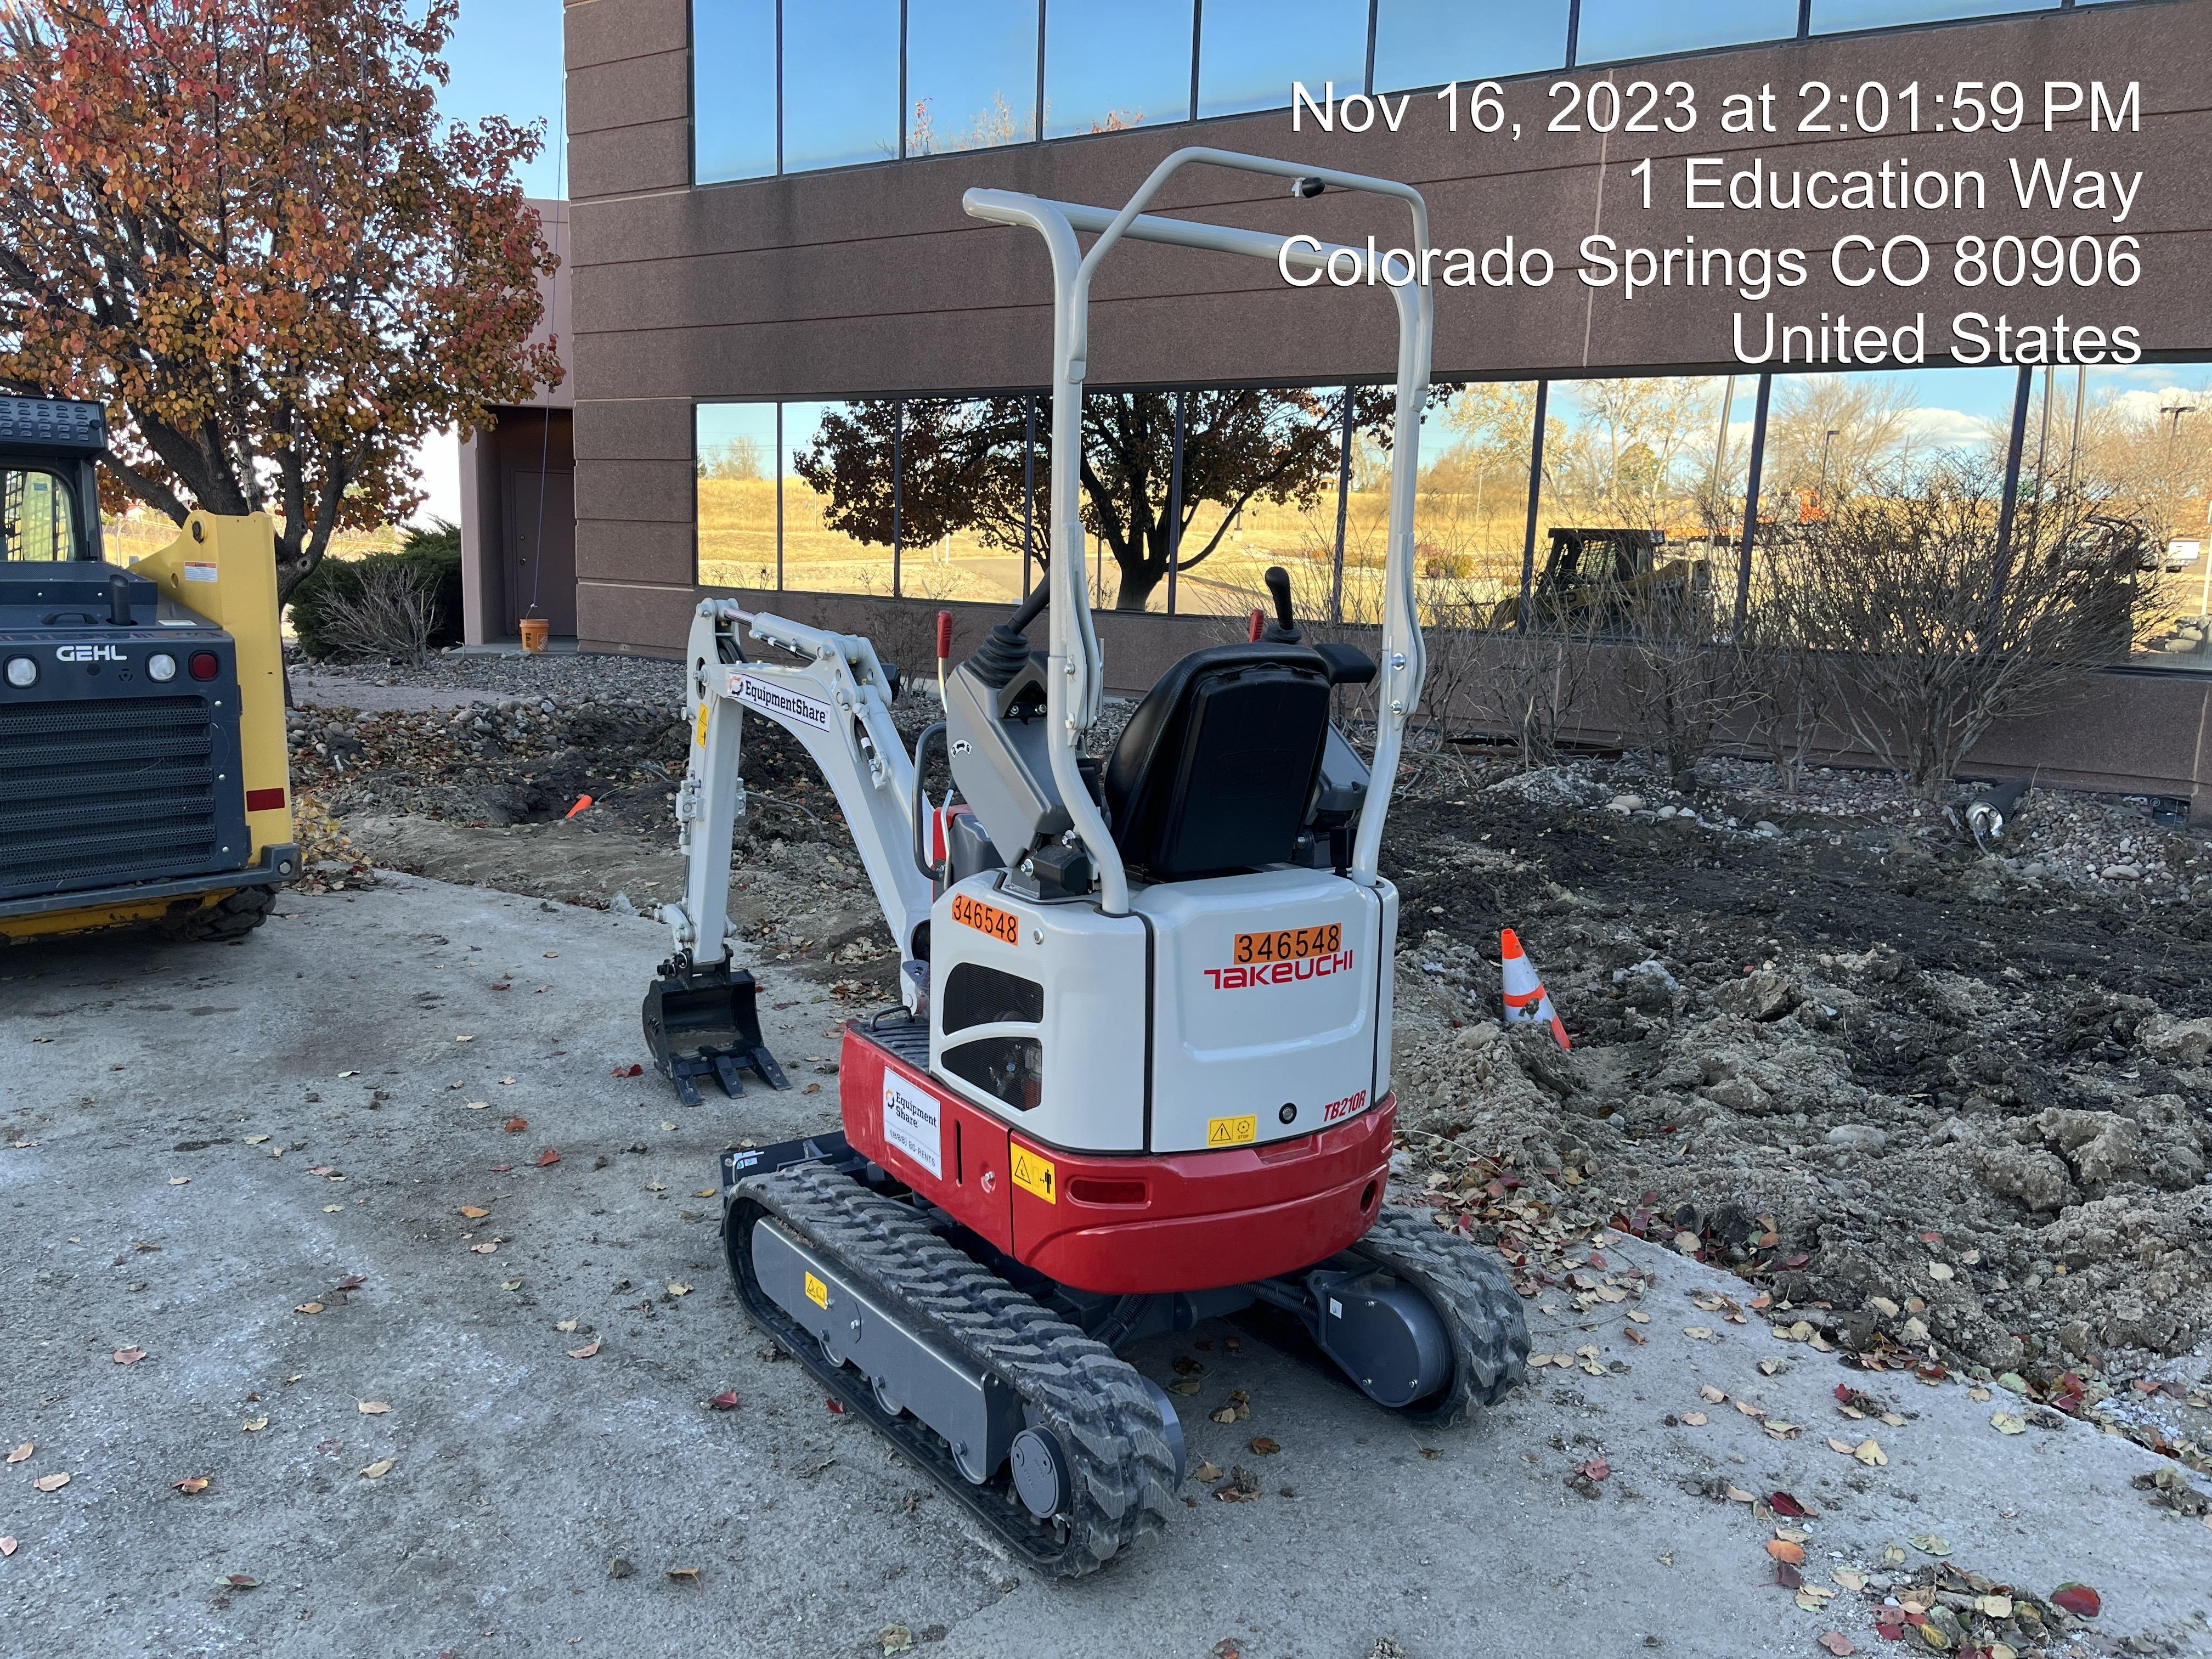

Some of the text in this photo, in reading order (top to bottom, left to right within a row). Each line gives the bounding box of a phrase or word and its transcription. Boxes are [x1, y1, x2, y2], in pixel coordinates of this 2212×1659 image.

[56, 645, 127, 662] GEHL
[745, 680, 826, 724] EquipmentShare
[953, 895, 1017, 944] 346548
[1237, 924, 1340, 963] 346548
[896, 1091, 937, 1127] Equipment
[896, 1105, 918, 1128] Share
[1323, 1088, 1367, 1122] TB210R
[890, 1129, 907, 1147] (888)
